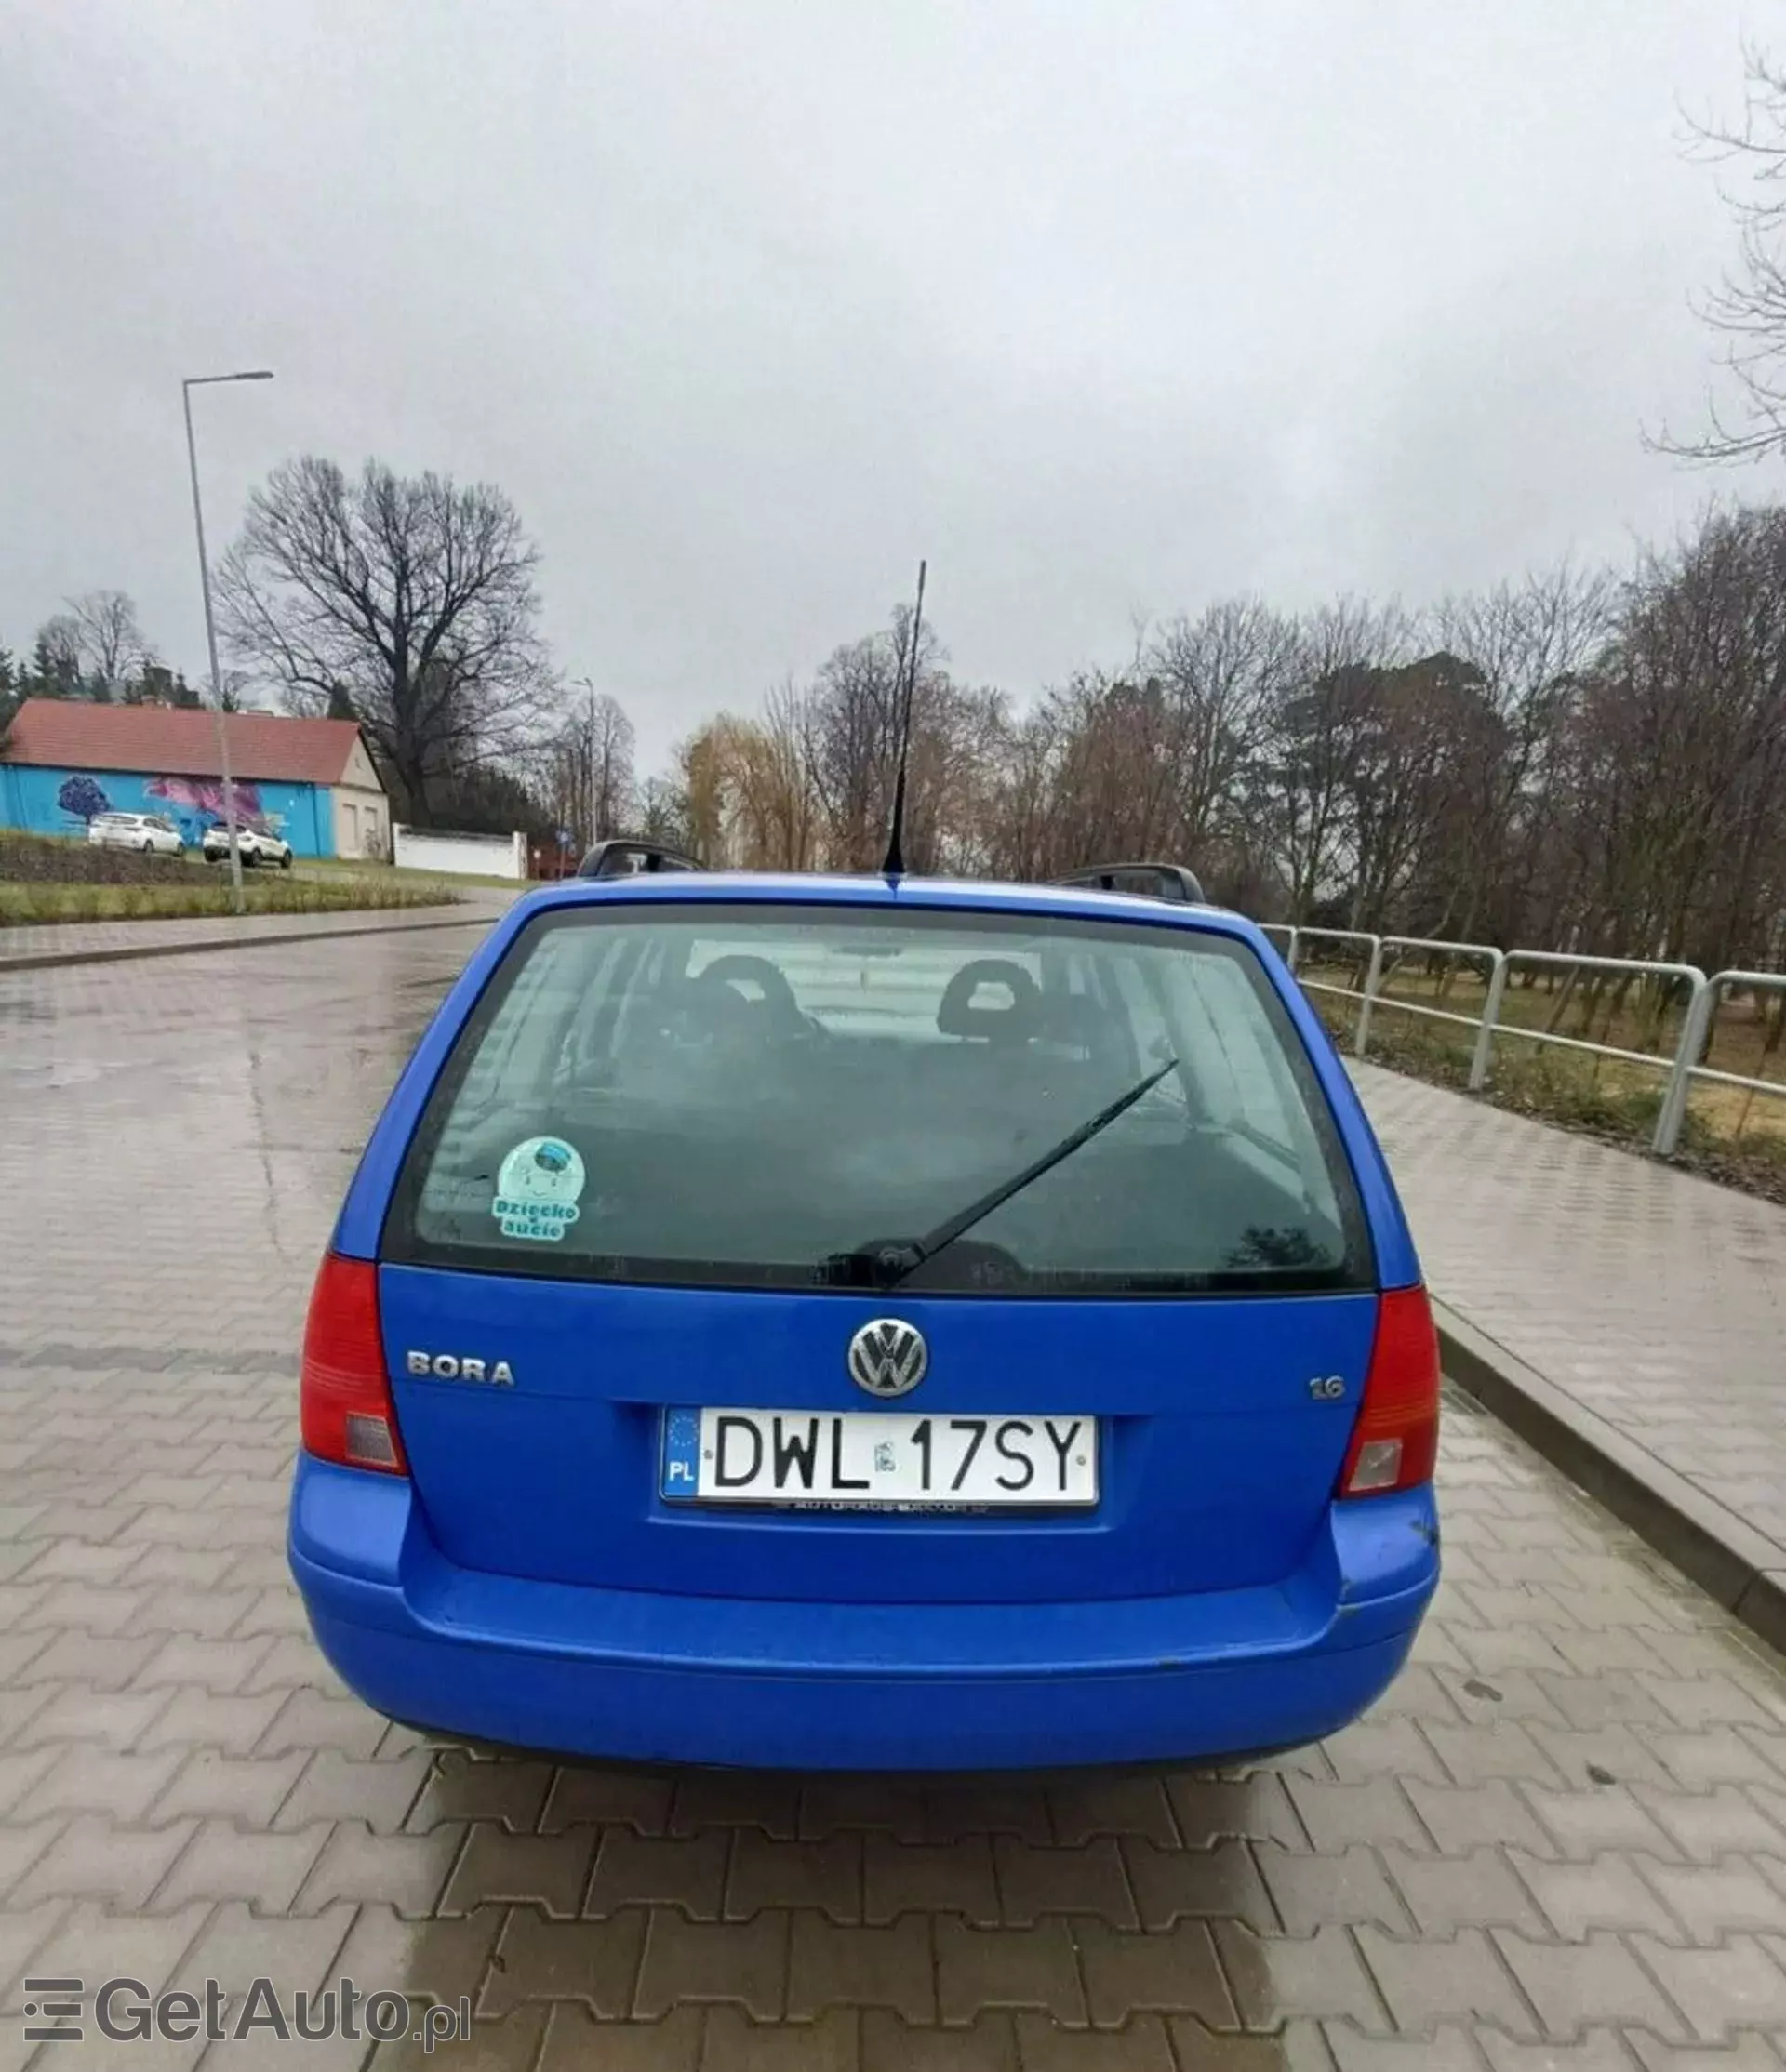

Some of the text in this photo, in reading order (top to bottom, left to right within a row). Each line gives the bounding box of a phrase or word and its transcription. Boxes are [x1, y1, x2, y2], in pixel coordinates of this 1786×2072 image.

[407, 1349, 515, 1387] BORA
[669, 1461, 694, 1481] PL
[714, 1415, 1082, 1492] DWL 17SY
